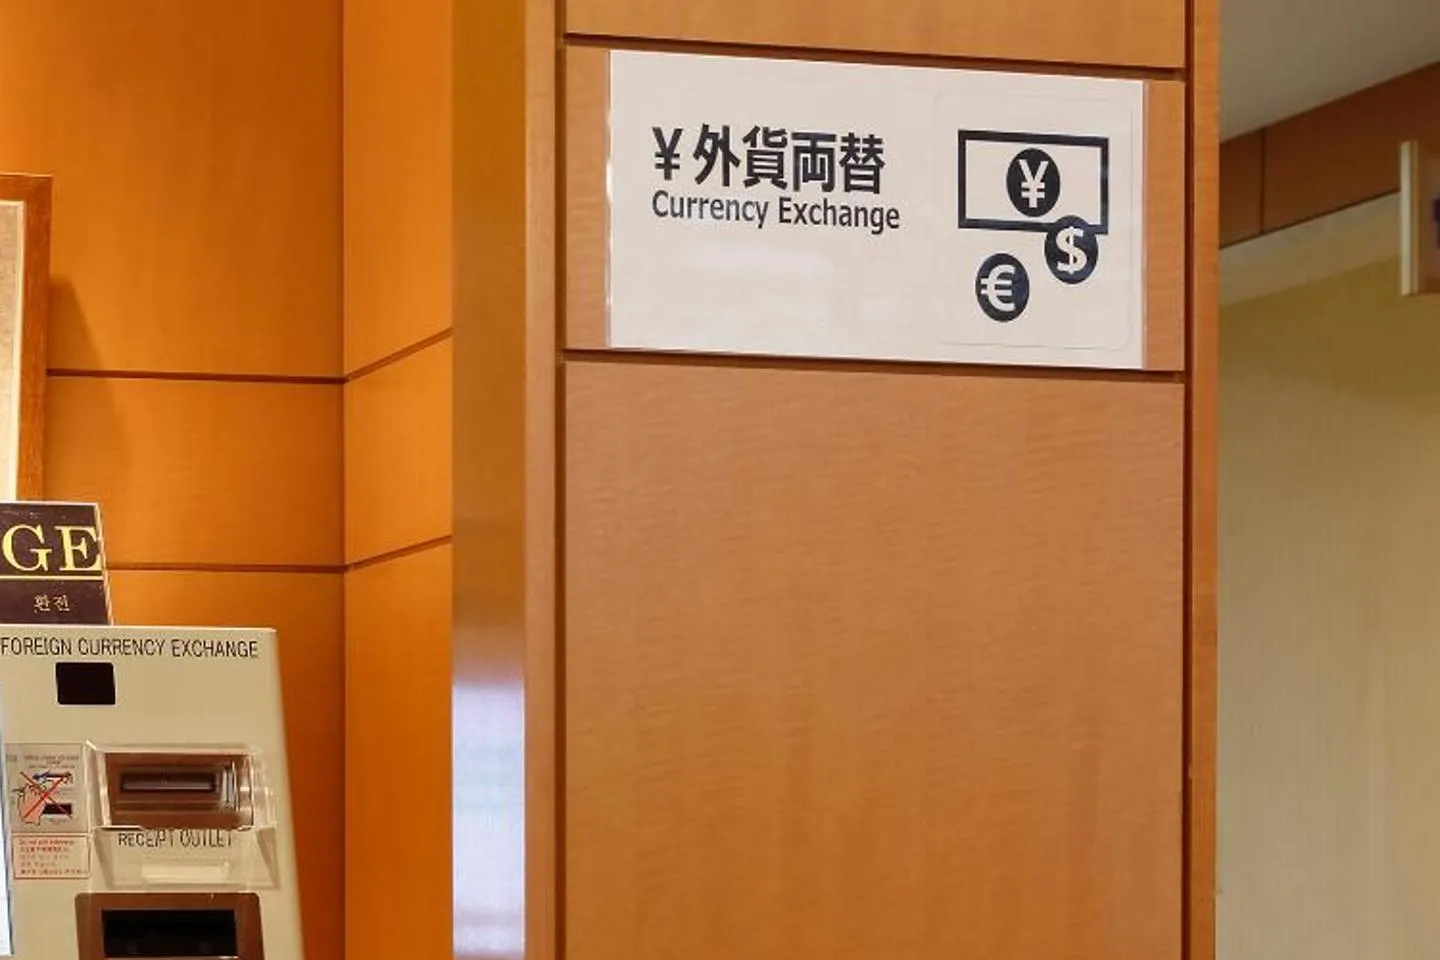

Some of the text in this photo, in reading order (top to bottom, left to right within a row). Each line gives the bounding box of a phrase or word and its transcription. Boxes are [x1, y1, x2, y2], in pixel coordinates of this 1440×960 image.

[692, 123, 887, 195] 外貨両替
[651, 190, 901, 235] Currency Exchange
[0, 636, 259, 659] FOREIGN CURRENCY EXCHANGE
[118, 829, 233, 848] RECEIPT OUTLET
